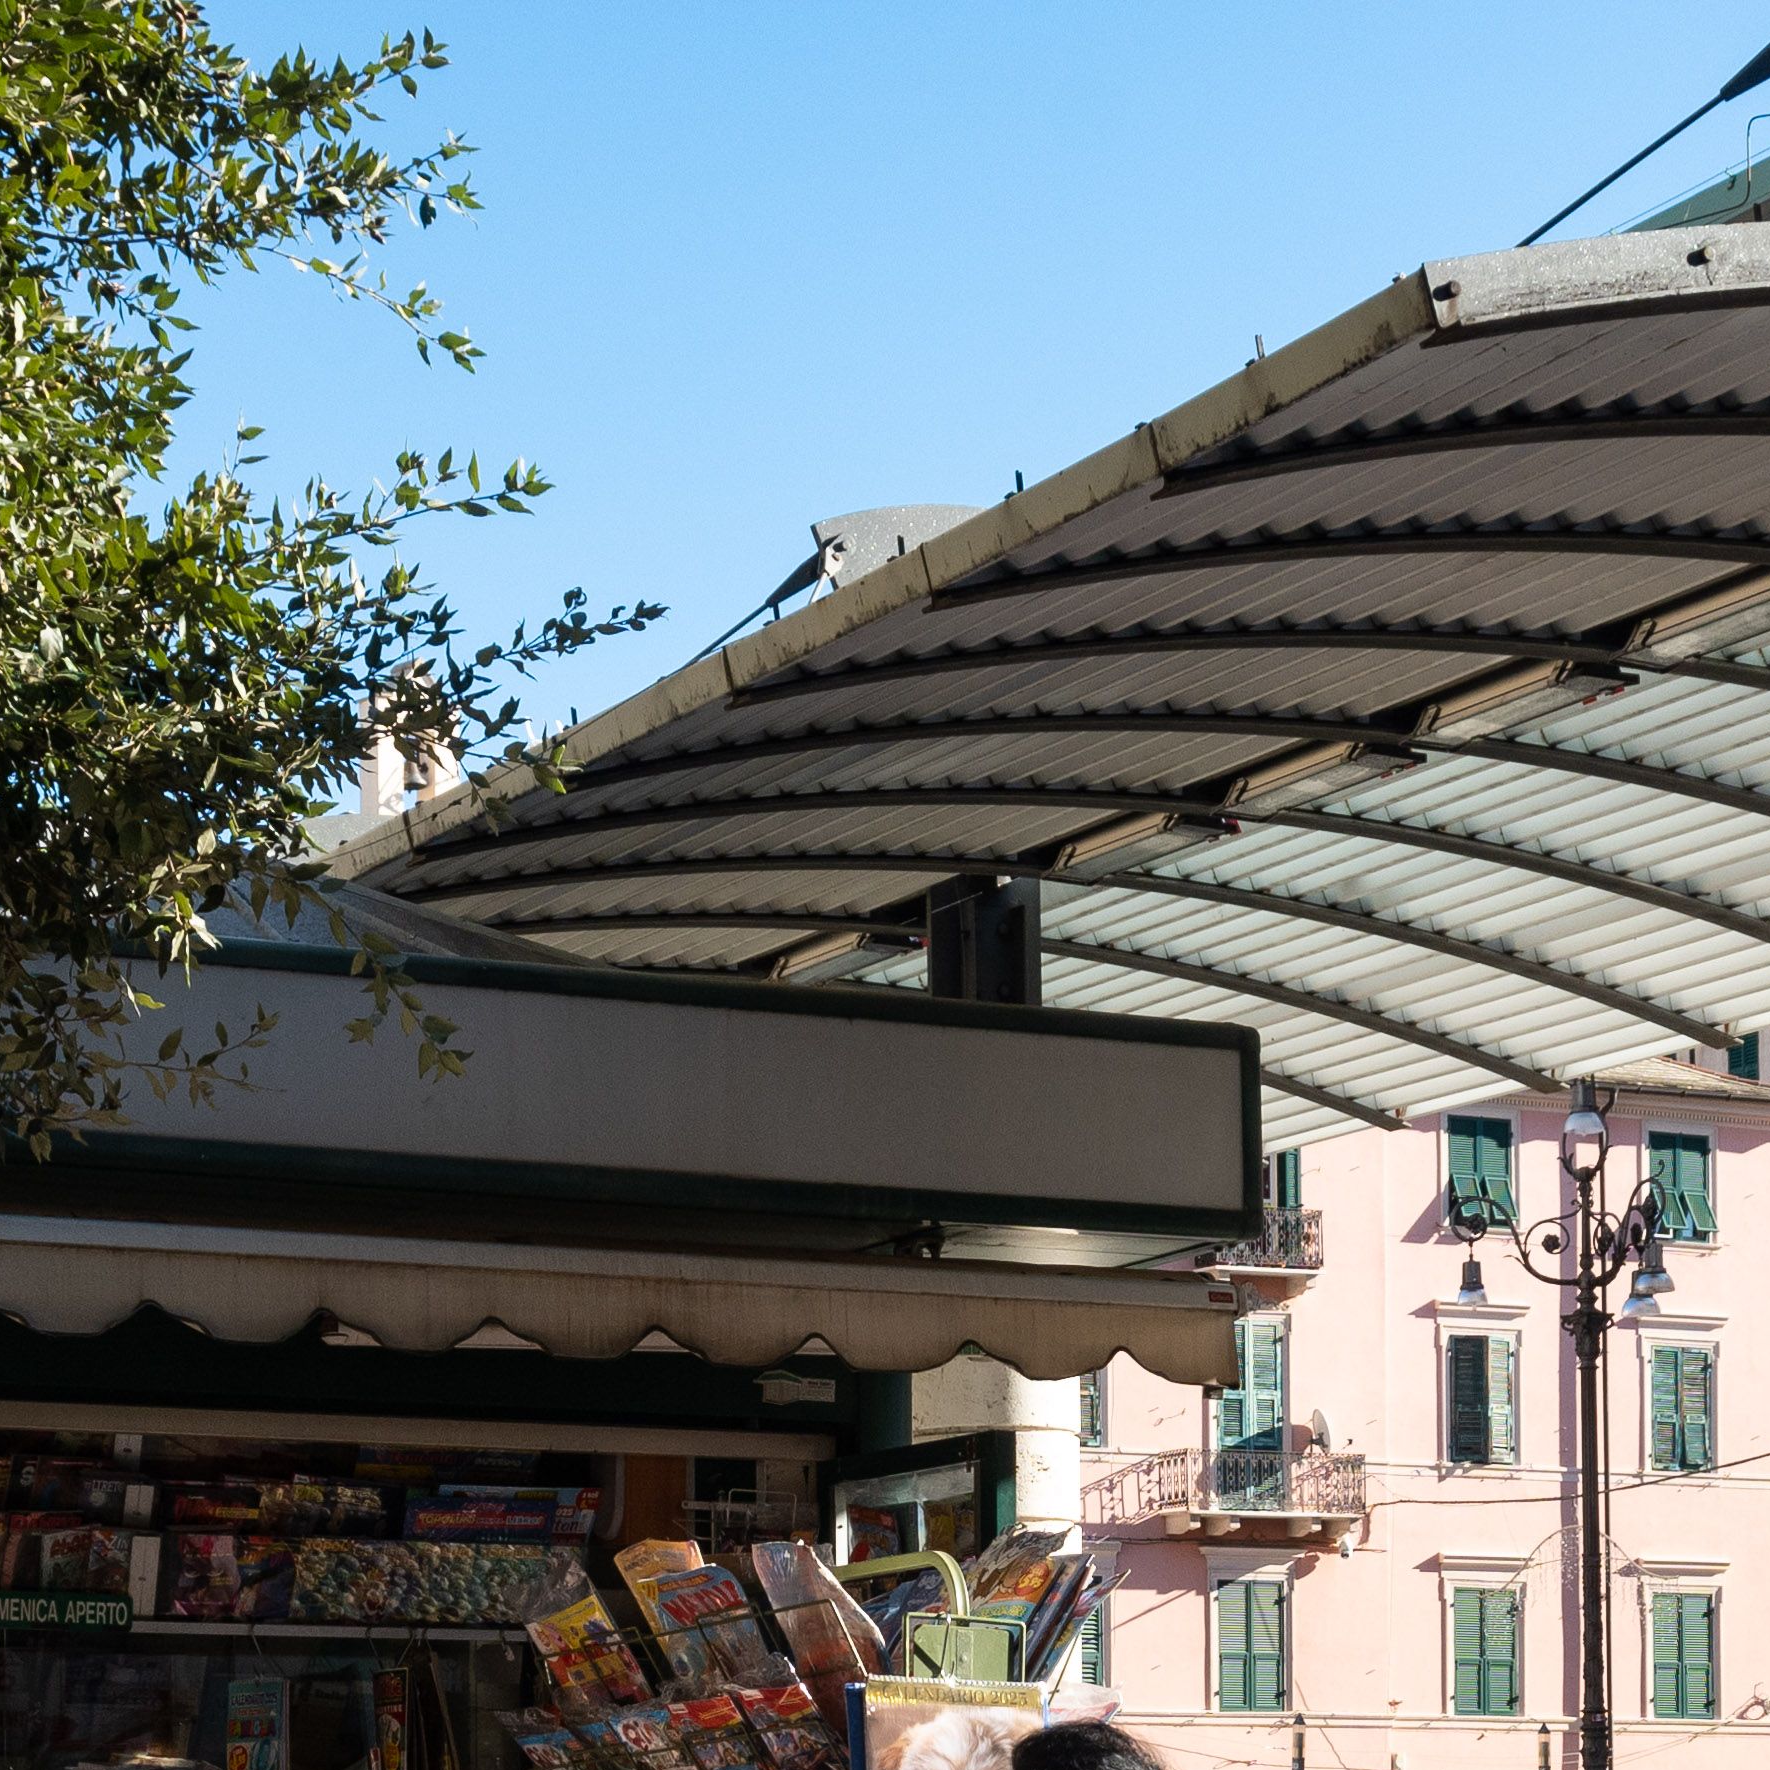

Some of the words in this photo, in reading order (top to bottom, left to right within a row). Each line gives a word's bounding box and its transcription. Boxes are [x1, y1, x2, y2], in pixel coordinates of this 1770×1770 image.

[65, 1600, 129, 1626] APERTO
[882, 1685, 986, 1704] CALENDARIO
[990, 1690, 1028, 1706] 2025
